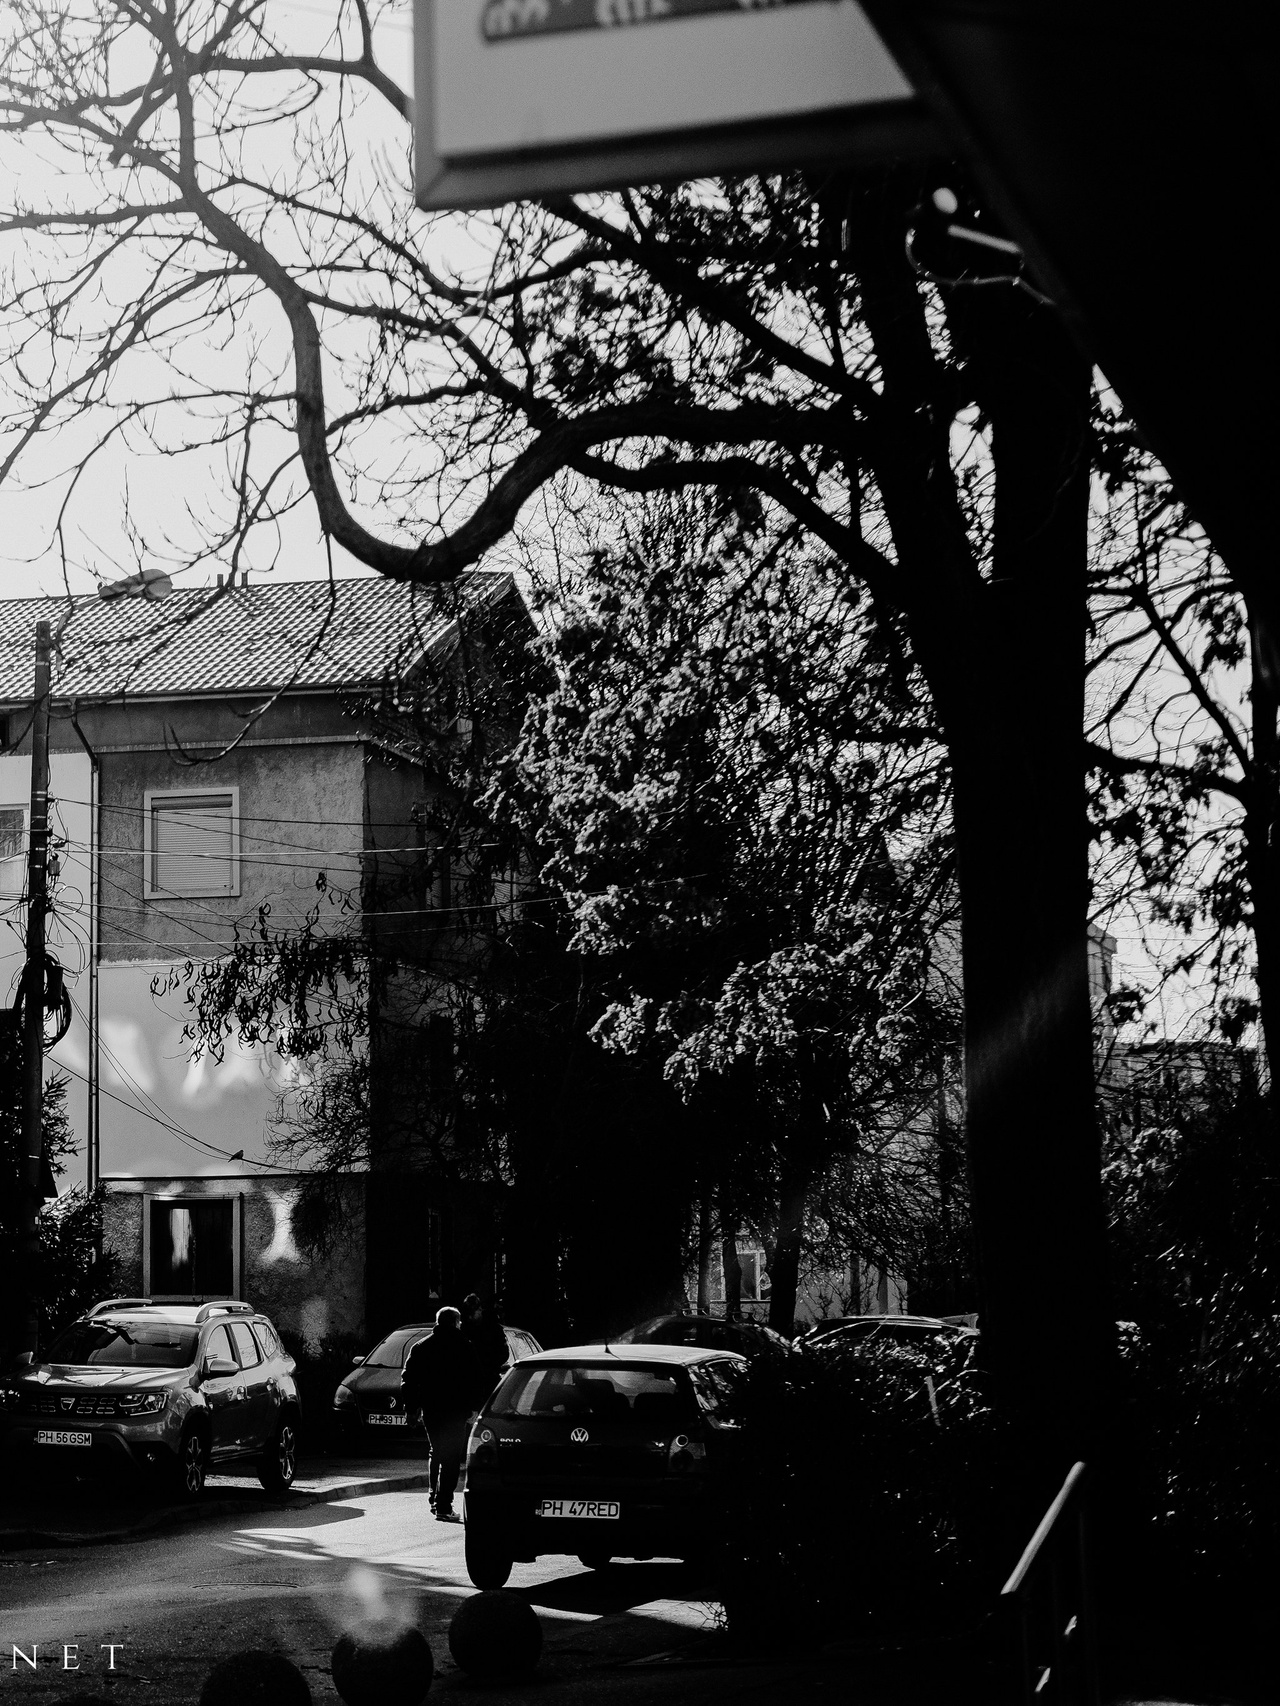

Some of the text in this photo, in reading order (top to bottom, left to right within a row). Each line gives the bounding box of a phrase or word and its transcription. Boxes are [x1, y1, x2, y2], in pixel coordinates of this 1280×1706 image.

[394, 1415, 407, 1425] TT
[38, 1432, 53, 1442] PH
[542, 1501, 564, 1516] PH
